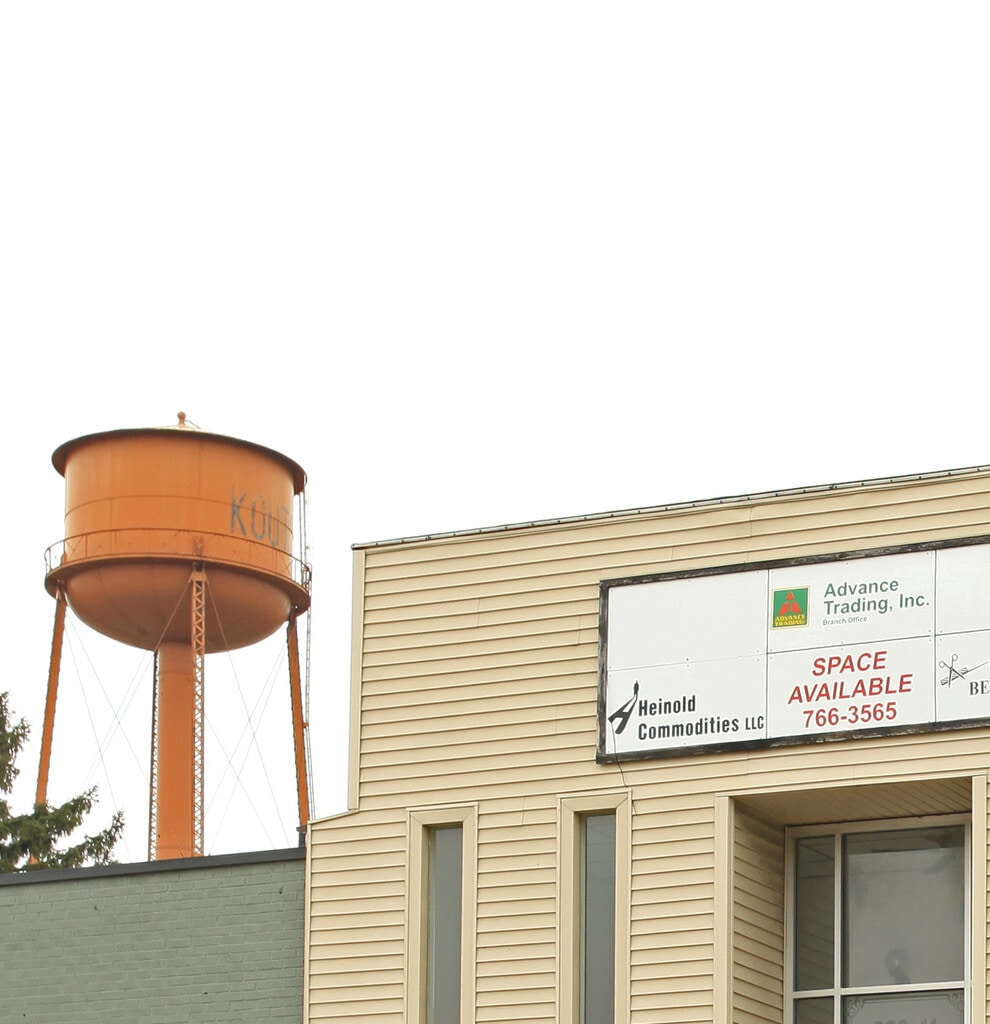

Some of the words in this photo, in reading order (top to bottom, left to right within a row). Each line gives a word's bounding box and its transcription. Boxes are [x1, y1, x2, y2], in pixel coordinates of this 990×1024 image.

[824, 580, 899, 598] Advance
[823, 597, 893, 616] Trading,
[899, 593, 930, 609] Inc.
[823, 618, 847, 626] Branch
[848, 616, 868, 624] Office
[812, 651, 887, 676] SPACE
[788, 674, 913, 704] AVAILABLE
[638, 695, 696, 717] Heinold
[803, 702, 897, 728] 766-3565
[638, 717, 739, 740] Commodities
[745, 716, 765, 730] LLC
